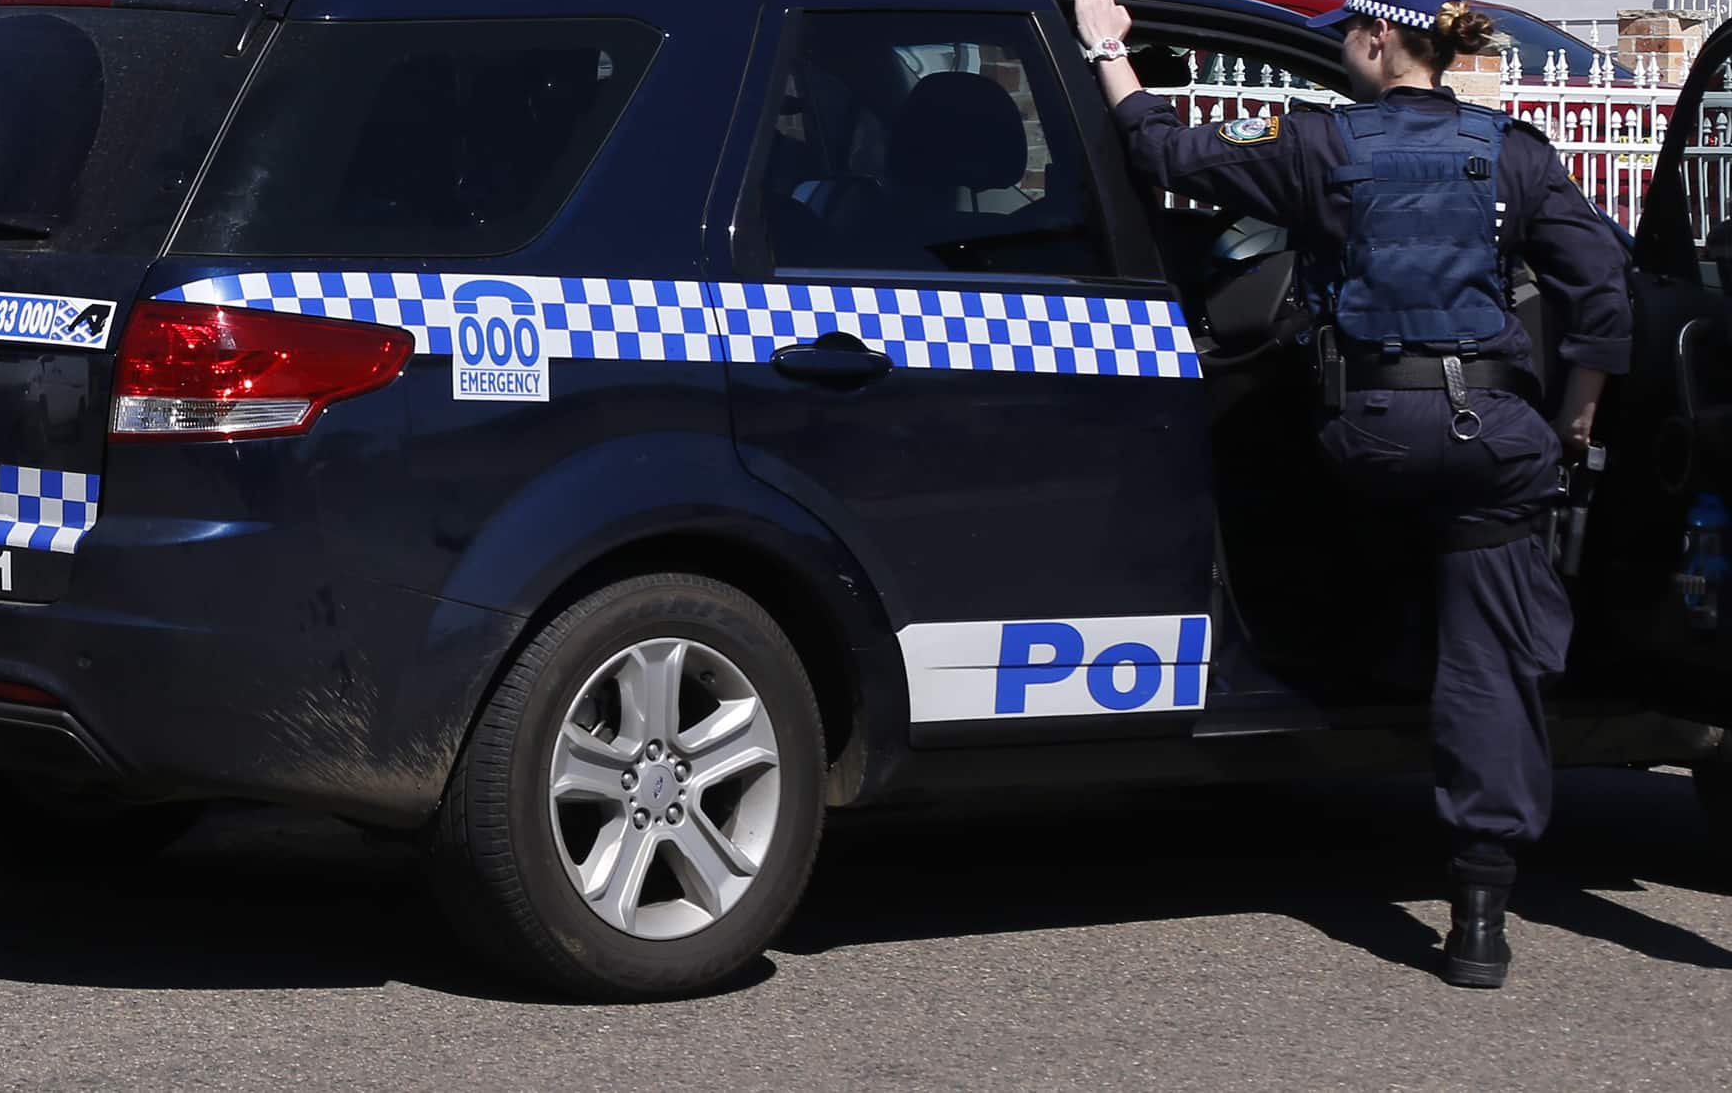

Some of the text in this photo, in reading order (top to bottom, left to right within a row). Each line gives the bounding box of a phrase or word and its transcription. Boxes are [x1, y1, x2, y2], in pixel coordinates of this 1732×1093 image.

[19, 300, 54, 335] 000
[458, 315, 540, 367] 000
[460, 371, 540, 394] EMERGENCY
[995, 617, 1207, 714] Pol
